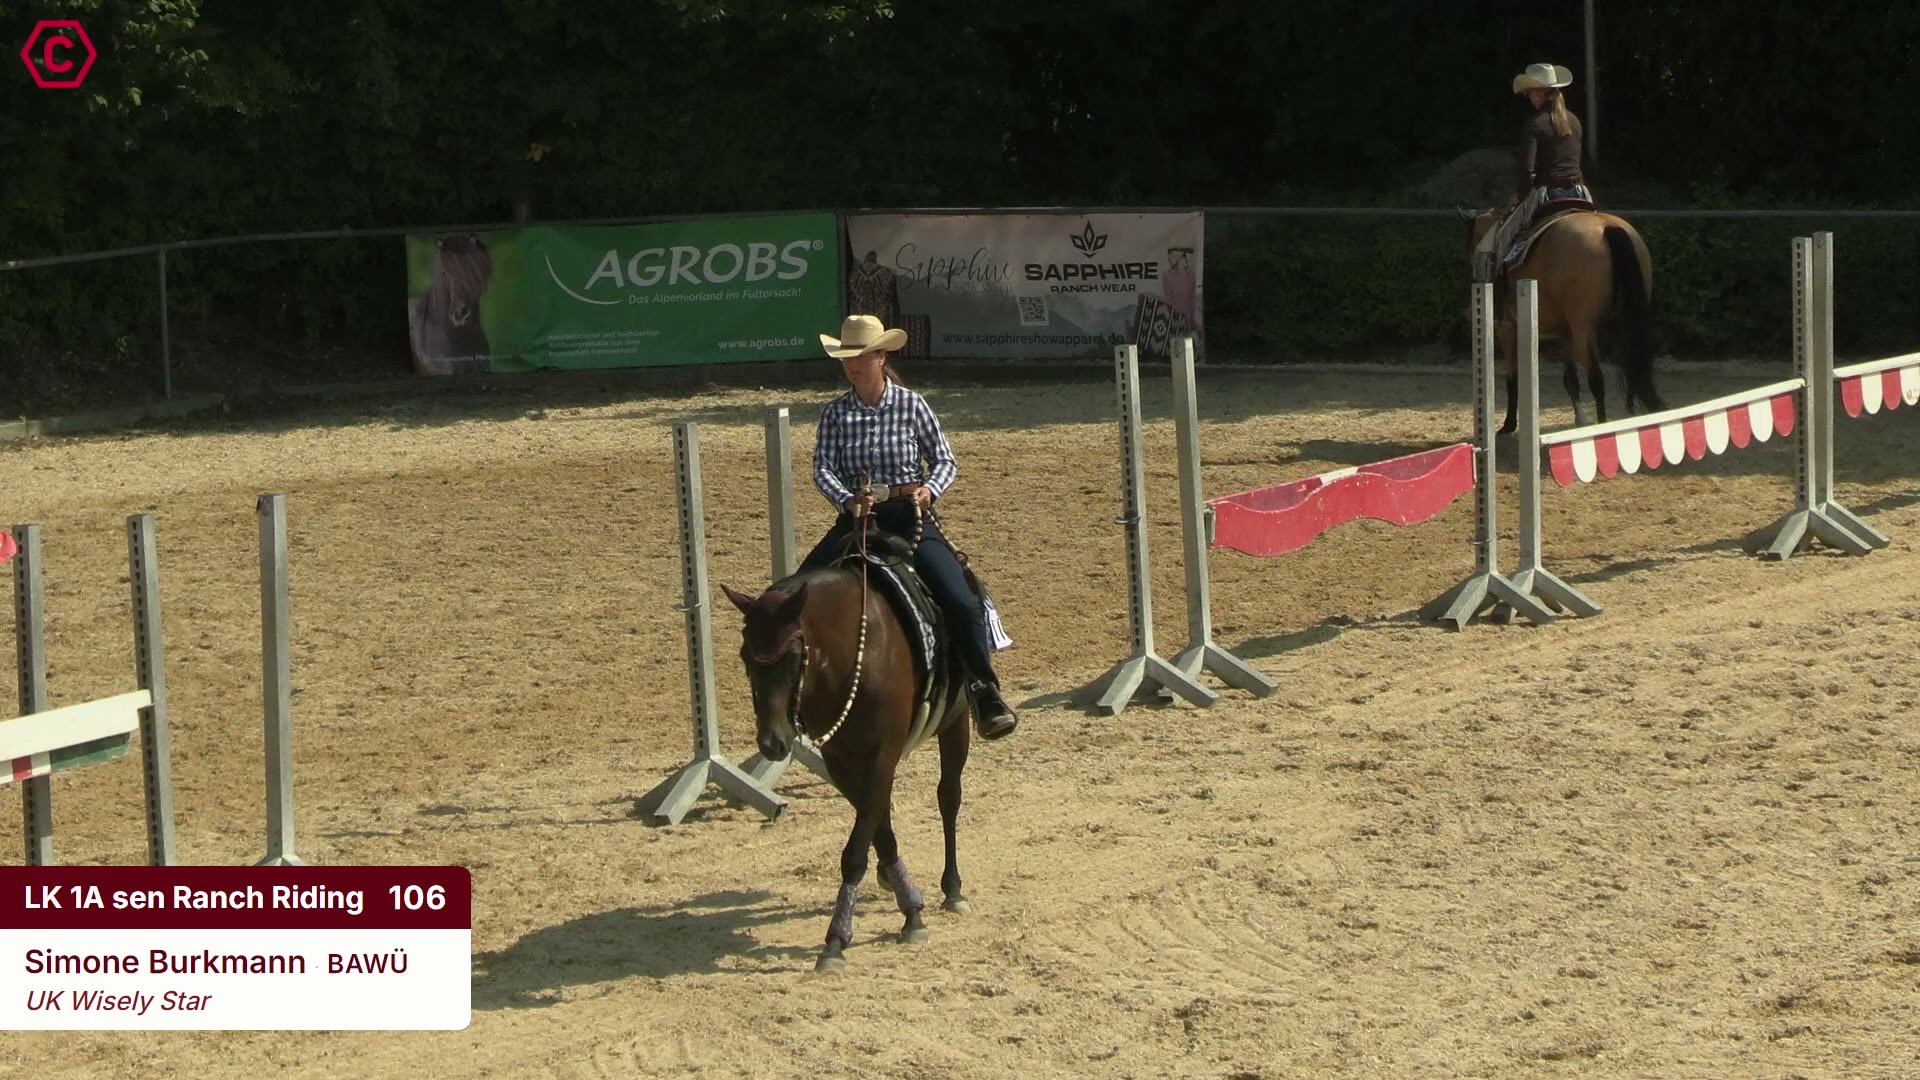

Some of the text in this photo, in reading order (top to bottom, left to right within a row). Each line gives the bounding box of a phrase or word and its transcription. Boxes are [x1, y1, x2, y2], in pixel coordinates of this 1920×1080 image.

[1024, 262, 1159, 281] SAPPHIRE
[1050, 283, 1136, 294] RANCH WEAR
[628, 294, 649, 305] Das
[652, 290, 723, 304] Alpenvorland
[726, 291, 739, 300] im
[718, 335, 804, 350] www.agrobs.de
[943, 331, 1125, 347] www.sapphireshowapparel.de
